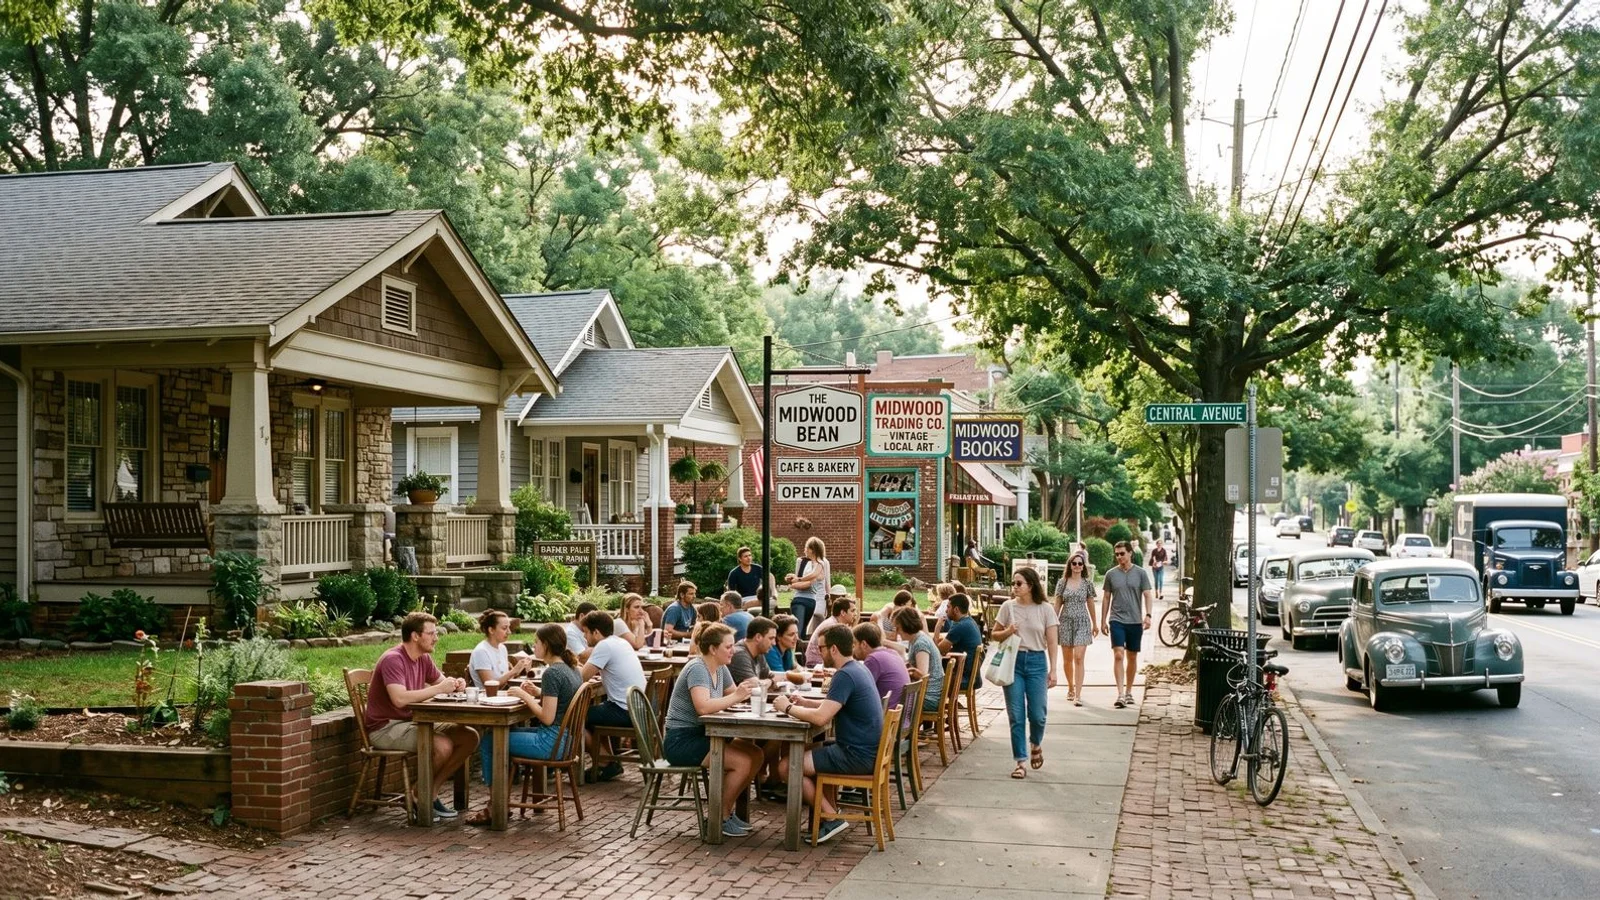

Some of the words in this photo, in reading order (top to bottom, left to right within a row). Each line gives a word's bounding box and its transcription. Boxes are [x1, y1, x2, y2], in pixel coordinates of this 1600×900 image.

[809, 394, 827, 404] THE
[779, 406, 857, 422] MIDWOOD
[875, 400, 943, 415] MIDWOOD
[1149, 407, 1196, 421] CENTRAL
[1201, 407, 1242, 421] AVENUE
[875, 417, 923, 429] TRADING
[926, 417, 945, 430] CO.
[797, 426, 839, 442] BEAN
[889, 431, 928, 441] VINTAGE
[955, 424, 1019, 438] MIDWOOD
[884, 442, 913, 451] LOCAL
[916, 442, 934, 451] ART
[960, 440, 1013, 457] BOOKS
[780, 462, 805, 472] CAFE
[807, 462, 815, 472] &
[818, 462, 855, 472] BAKERY
[782, 486, 820, 499] OPEN
[824, 486, 854, 499] 7AM
